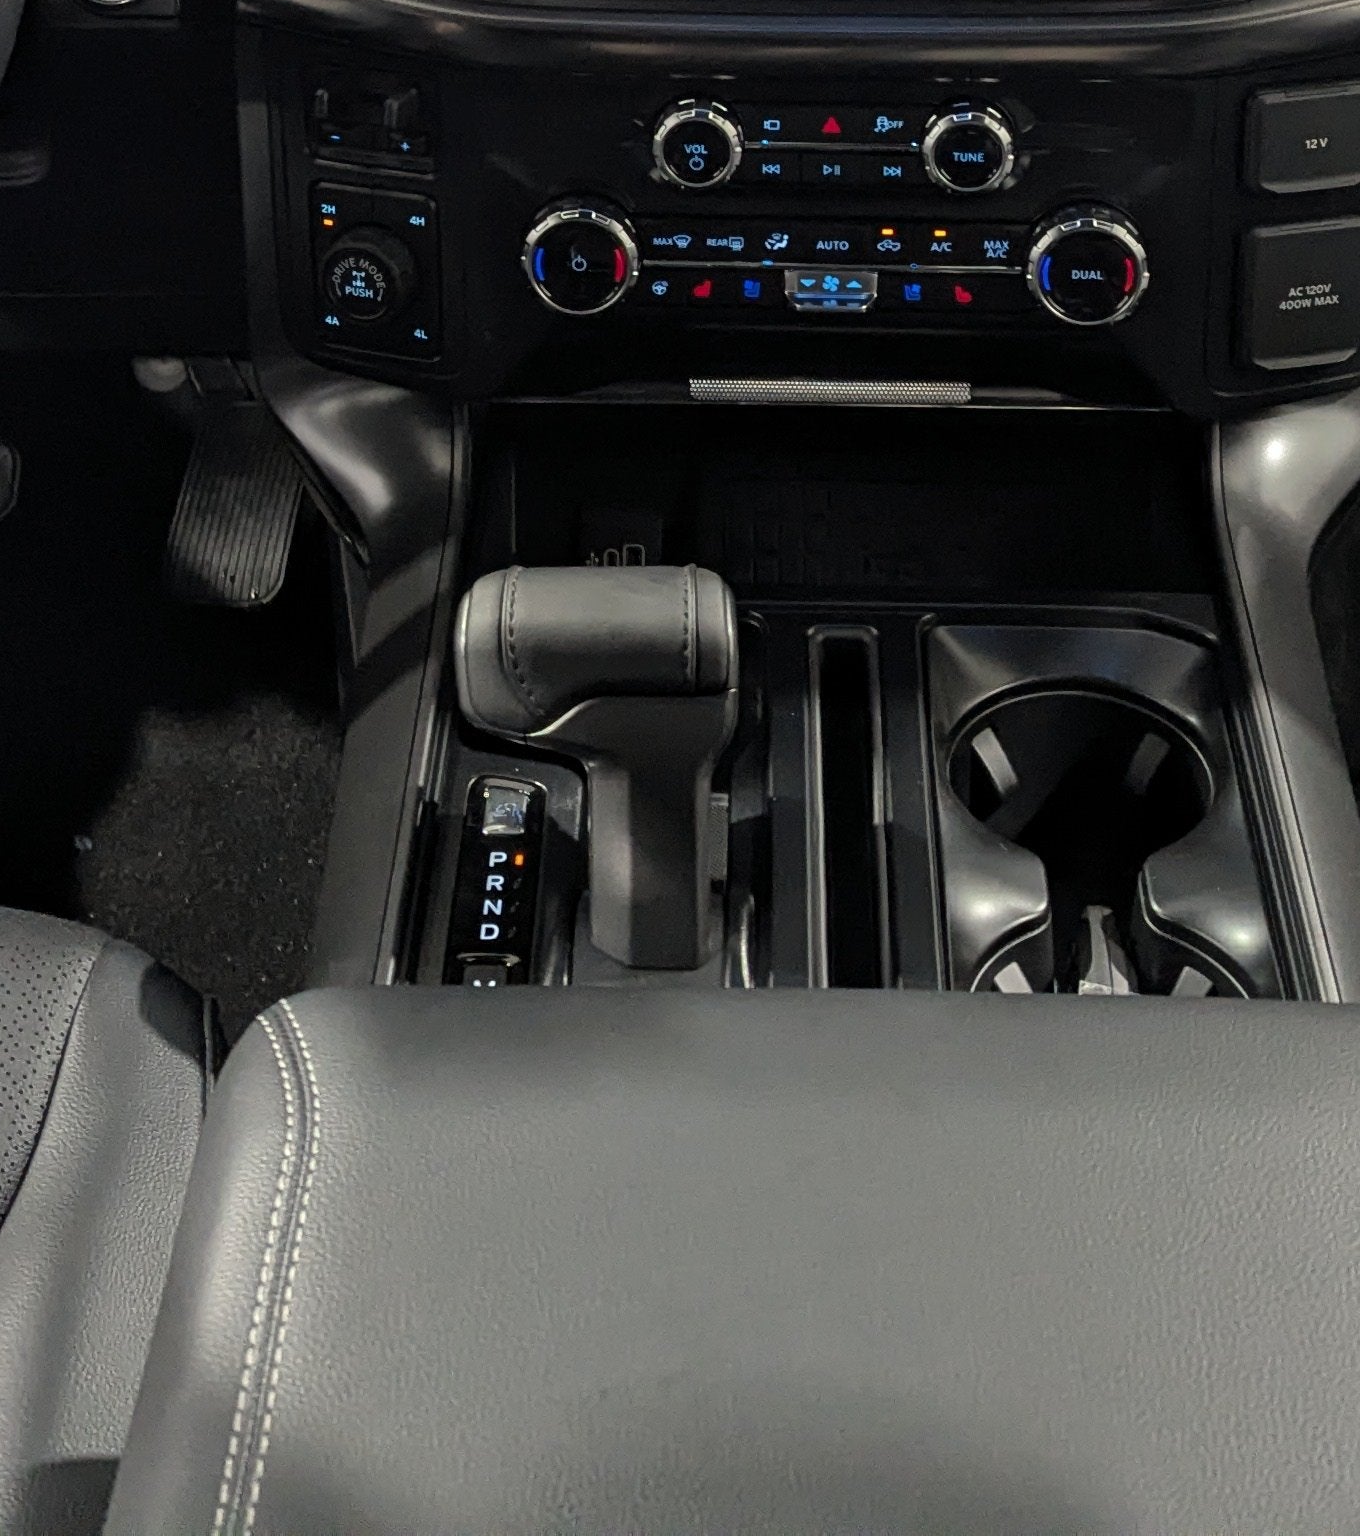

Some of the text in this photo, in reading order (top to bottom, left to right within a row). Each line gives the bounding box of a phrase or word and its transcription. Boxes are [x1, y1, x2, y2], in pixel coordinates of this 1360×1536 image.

[887, 120, 904, 129] OFF
[684, 143, 708, 154] VOL
[1305, 137, 1328, 149] 12 V
[952, 151, 985, 163] TUNE
[321, 204, 336, 214] 2H
[409, 216, 425, 226] 4H
[653, 237, 674, 246] MAX
[706, 238, 728, 247] REAR
[816, 240, 850, 251] AUTO
[930, 242, 952, 252] A/C
[983, 240, 1009, 250] MAX
[986, 249, 1007, 259] A/C
[332, 258, 386, 289] DRIVE MODE
[1071, 269, 1103, 280] DUAL
[345, 286, 374, 299] PUSH
[1288, 283, 1331, 298] AC 120V
[1279, 294, 1339, 310] 400W MAX
[325, 316, 340, 326] 4A
[414, 329, 428, 340] 4L
[489, 851, 507, 867] P
[485, 875, 505, 891] R
[482, 899, 503, 915] N
[479, 924, 500, 941] D
